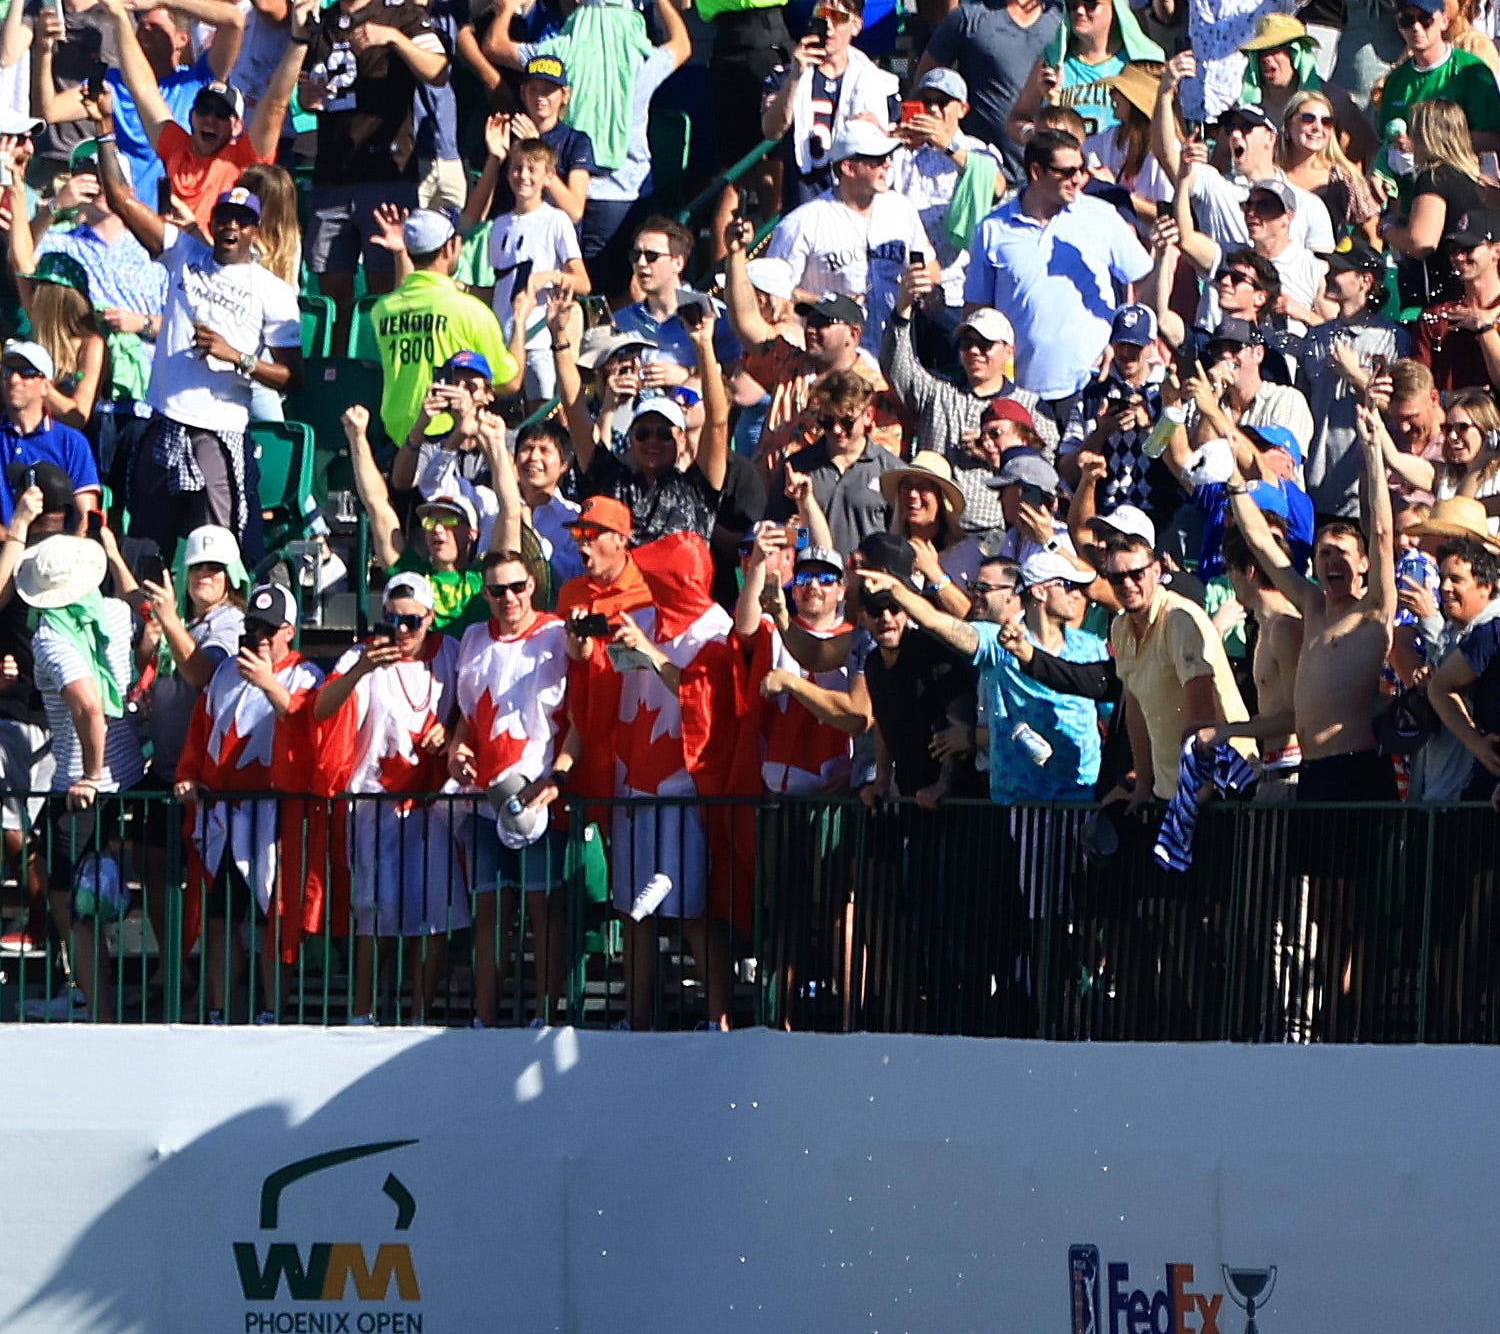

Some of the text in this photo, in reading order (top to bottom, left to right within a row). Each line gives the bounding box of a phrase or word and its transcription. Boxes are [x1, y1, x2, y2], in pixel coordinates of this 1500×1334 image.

[380, 314, 448, 336] VENDOR
[389, 337, 435, 365] 1800
[233, 1241, 422, 1301] WM
[244, 1312, 423, 1334] PHOENIX OPEN
